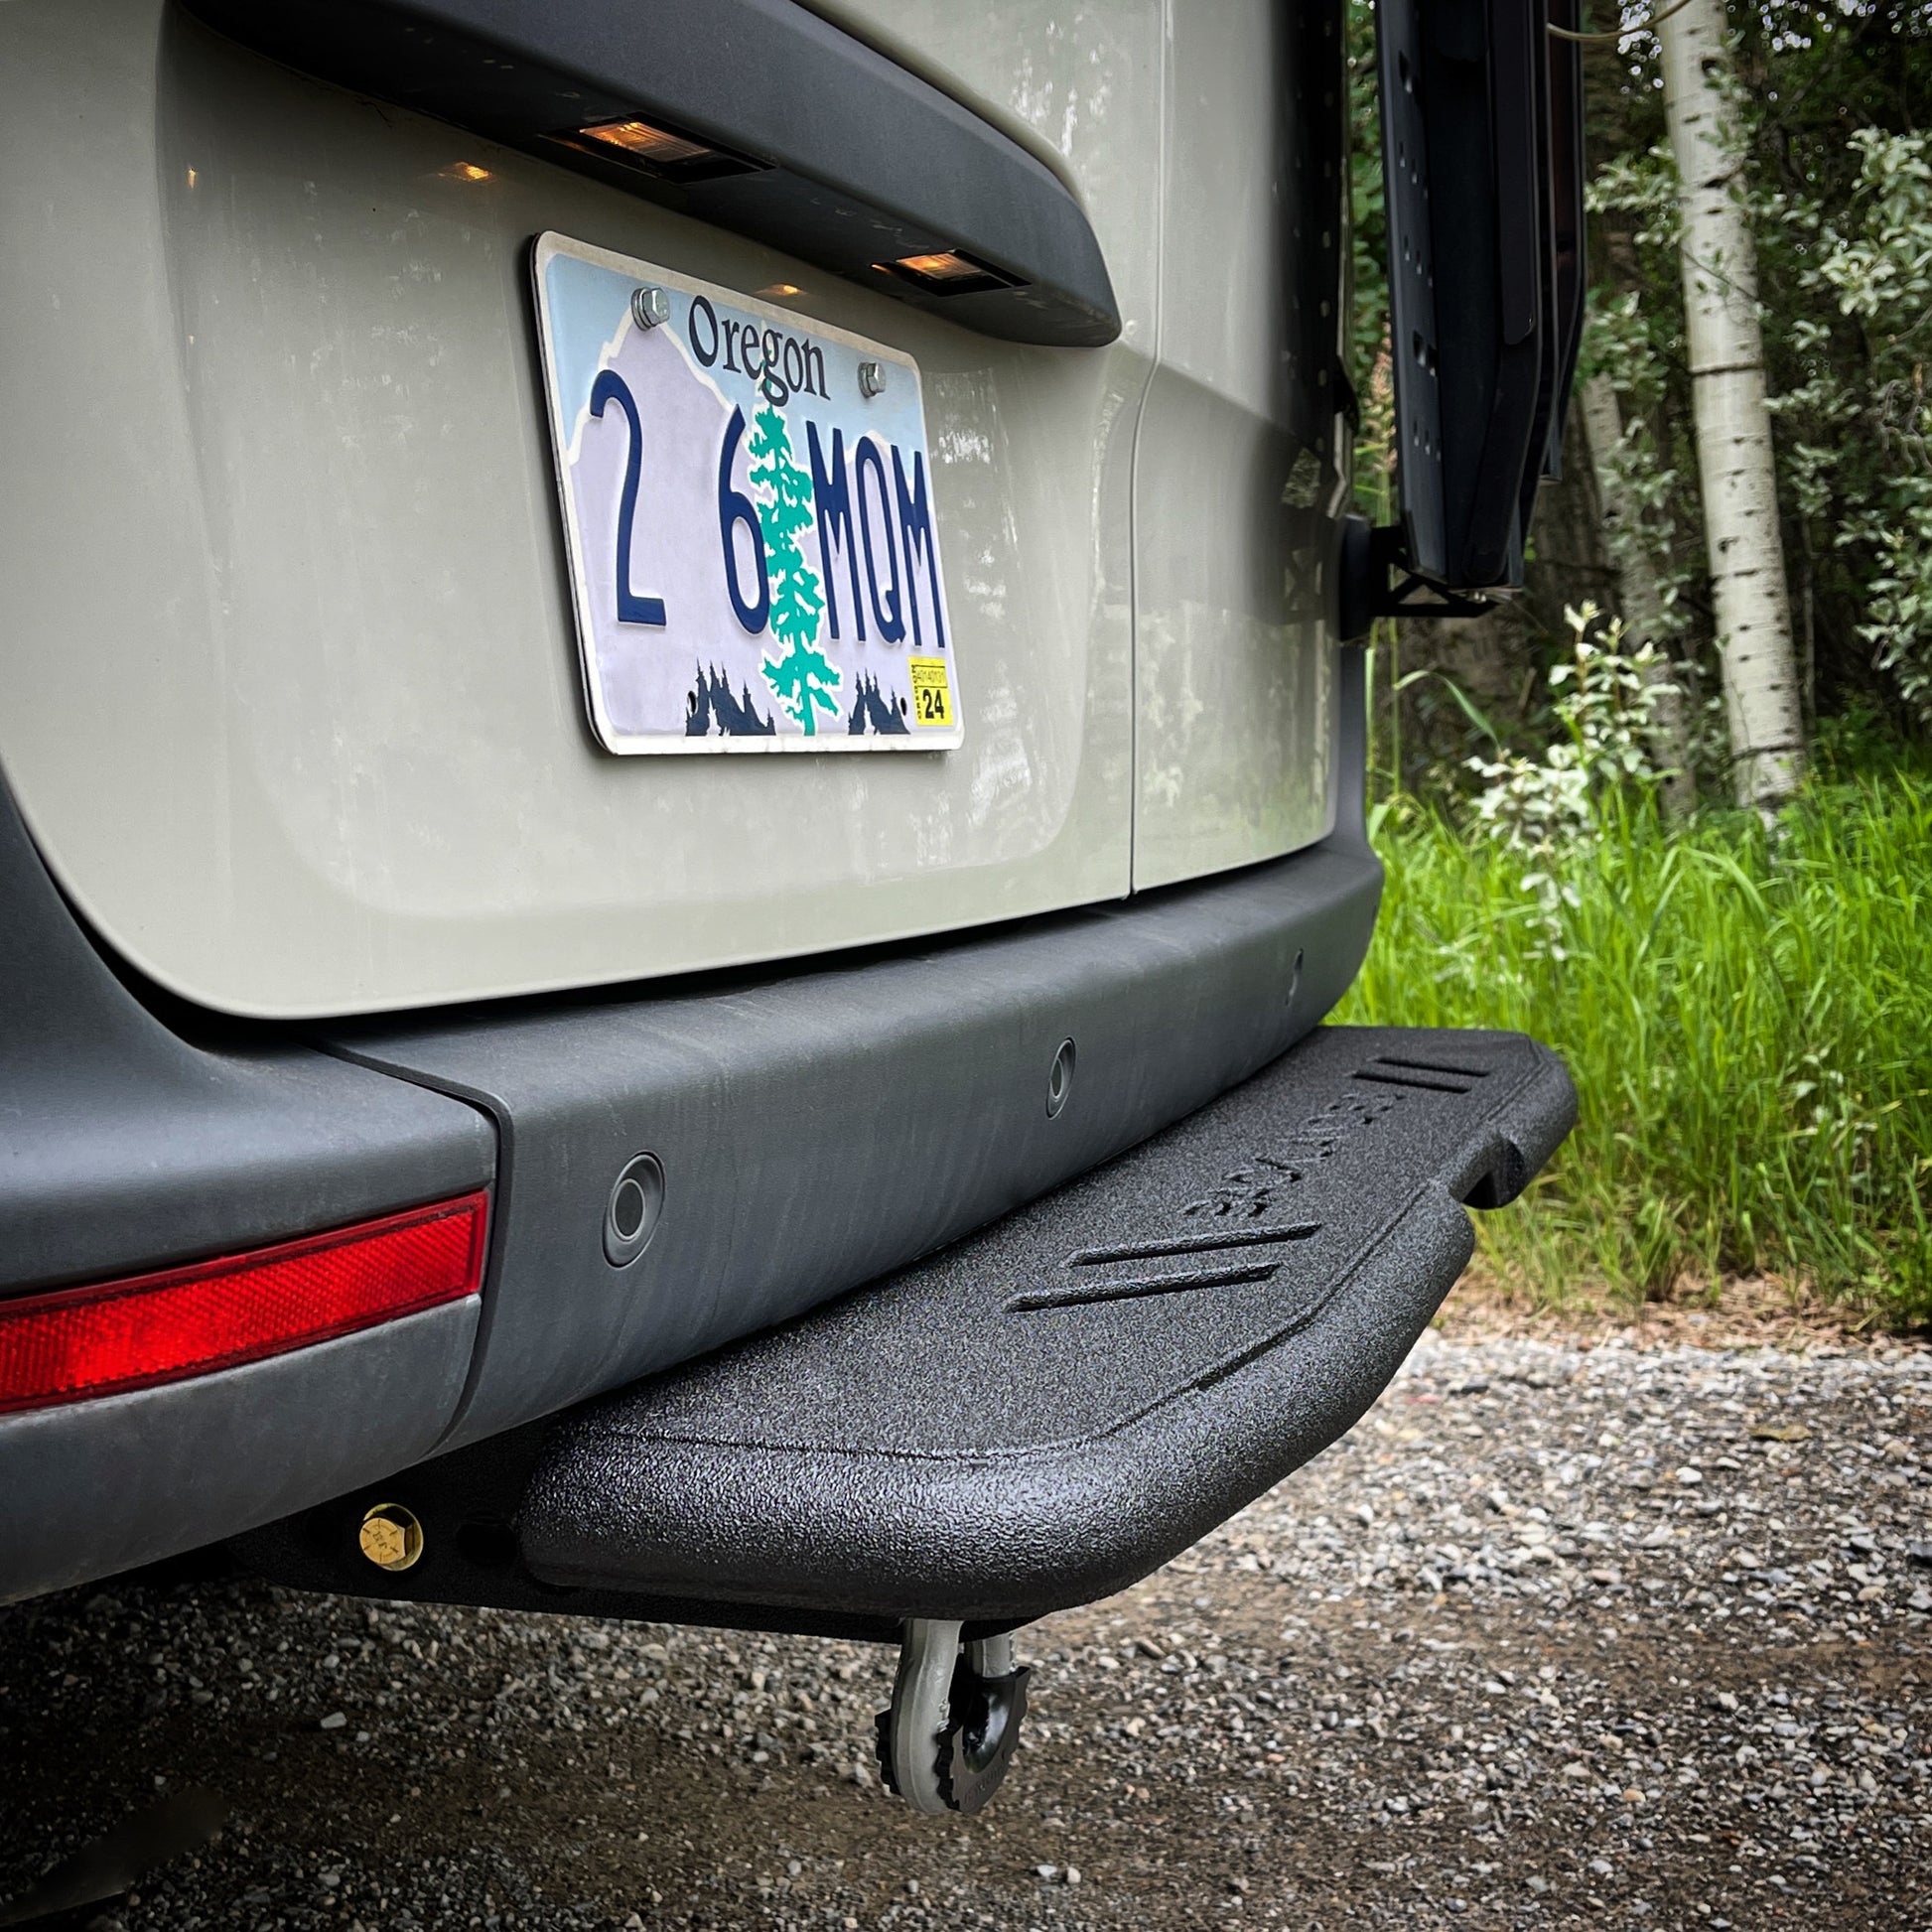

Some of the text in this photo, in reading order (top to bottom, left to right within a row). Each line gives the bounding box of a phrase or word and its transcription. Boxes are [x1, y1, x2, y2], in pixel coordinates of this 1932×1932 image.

[689, 295, 831, 407] Oregon
[806, 420, 946, 648] MQM
[922, 688, 945, 720] 24
